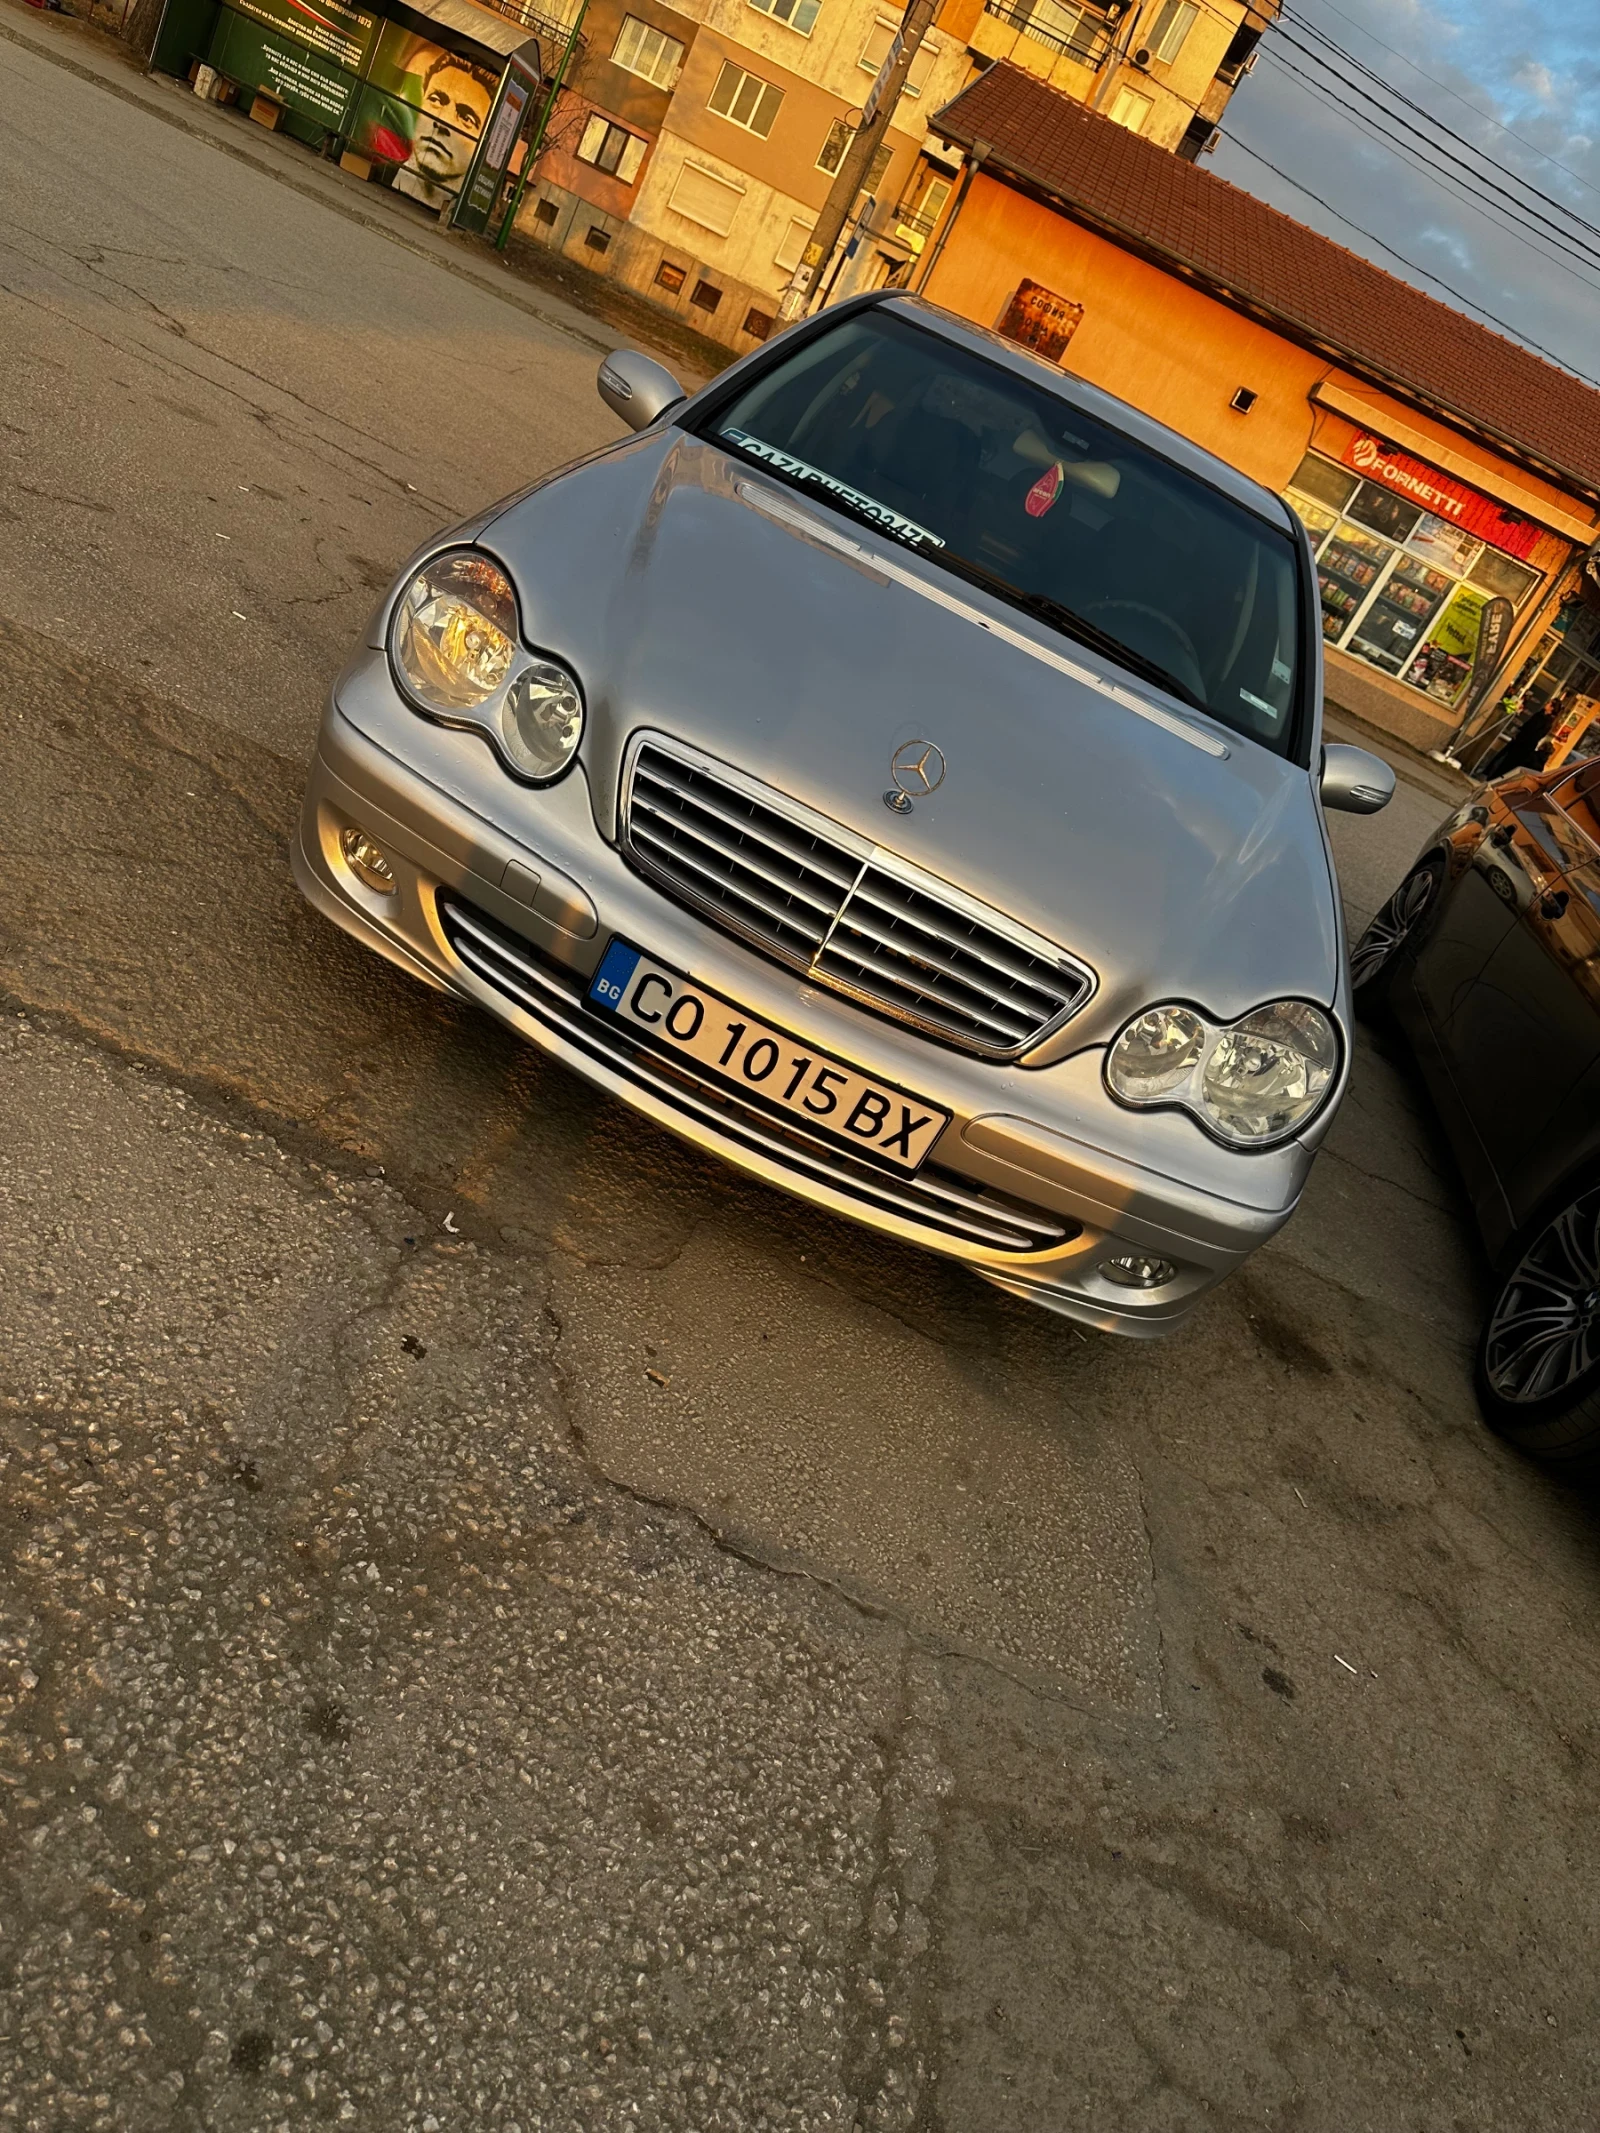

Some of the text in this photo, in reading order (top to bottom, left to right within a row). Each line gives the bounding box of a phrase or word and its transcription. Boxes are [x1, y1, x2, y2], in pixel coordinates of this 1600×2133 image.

[357, 14, 373, 29] 1873
[1031, 296, 1066, 320] СОФИЯ
[1371, 458, 1465, 516] FORNETTI
[596, 978, 621, 1000] BG
[629, 972, 705, 1041] CO
